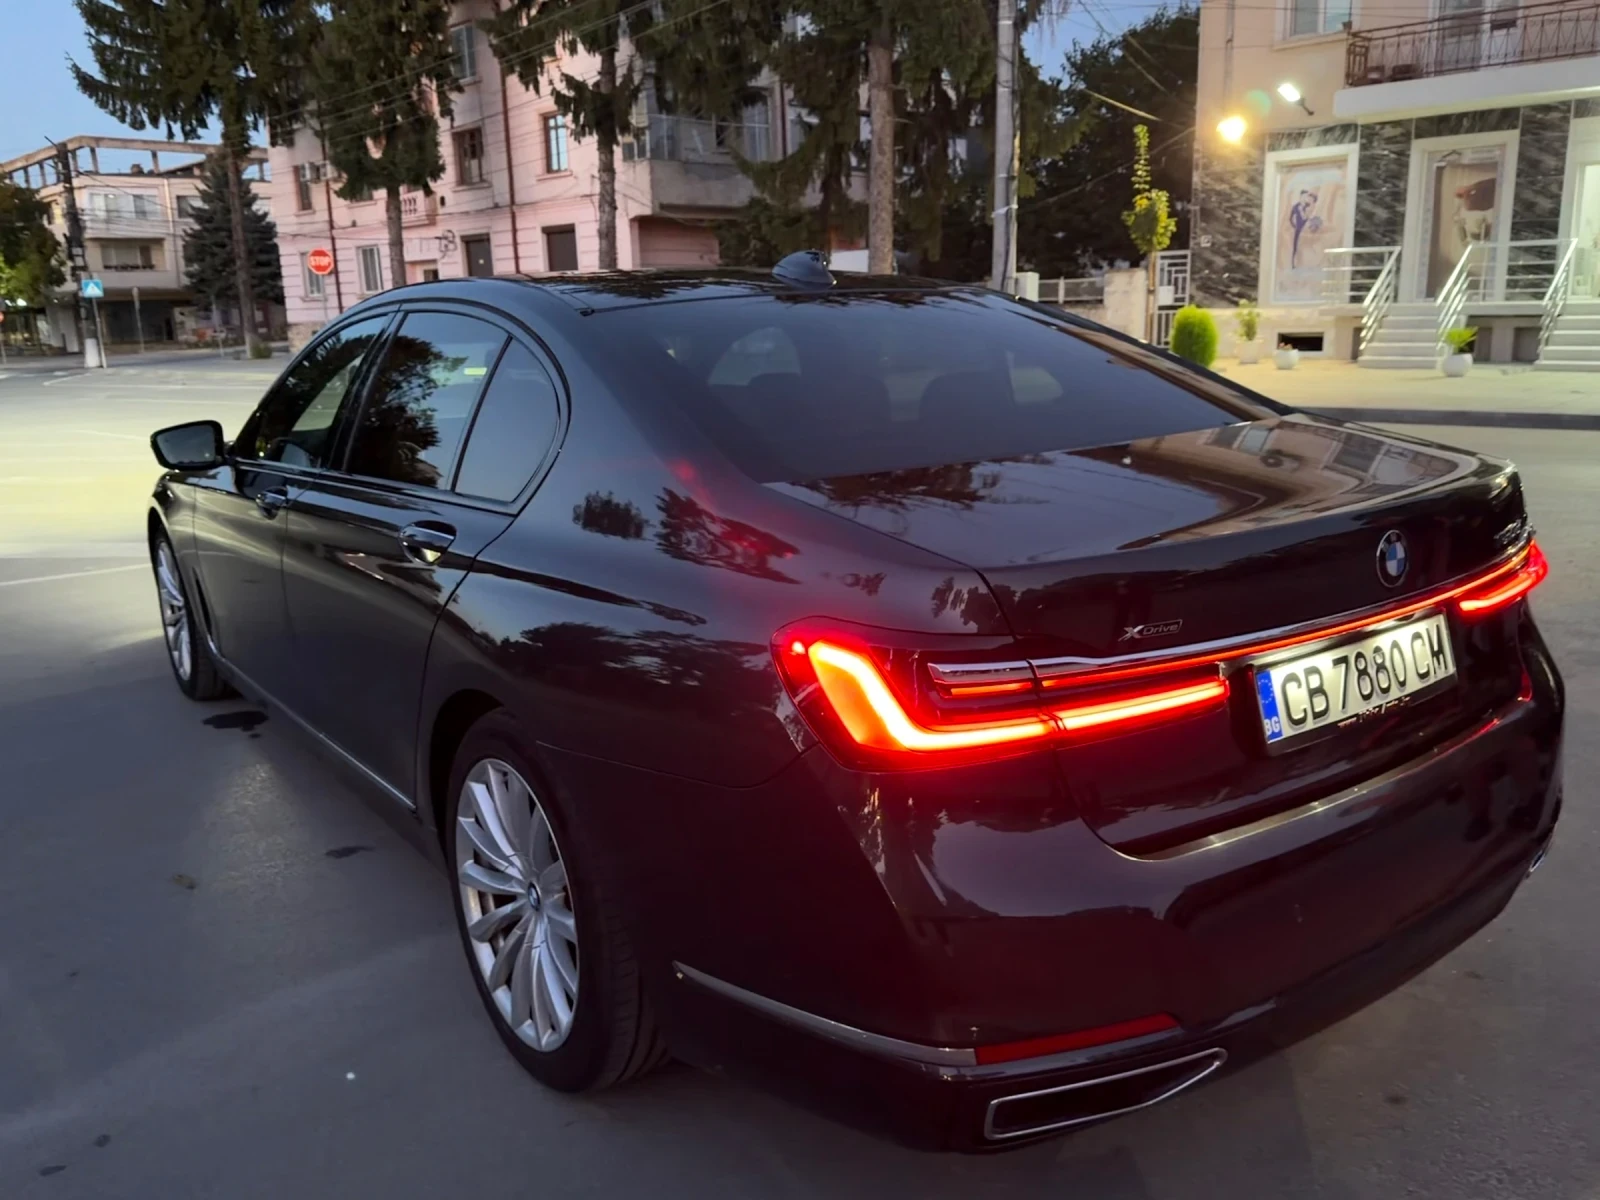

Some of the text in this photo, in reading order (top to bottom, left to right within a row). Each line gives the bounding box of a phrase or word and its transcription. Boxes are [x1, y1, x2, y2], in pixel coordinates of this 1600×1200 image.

[1280, 665, 1330, 726] CB
[1332, 639, 1407, 710] 7880
[1410, 623, 1448, 680] CM
[1264, 716, 1281, 736] BG
